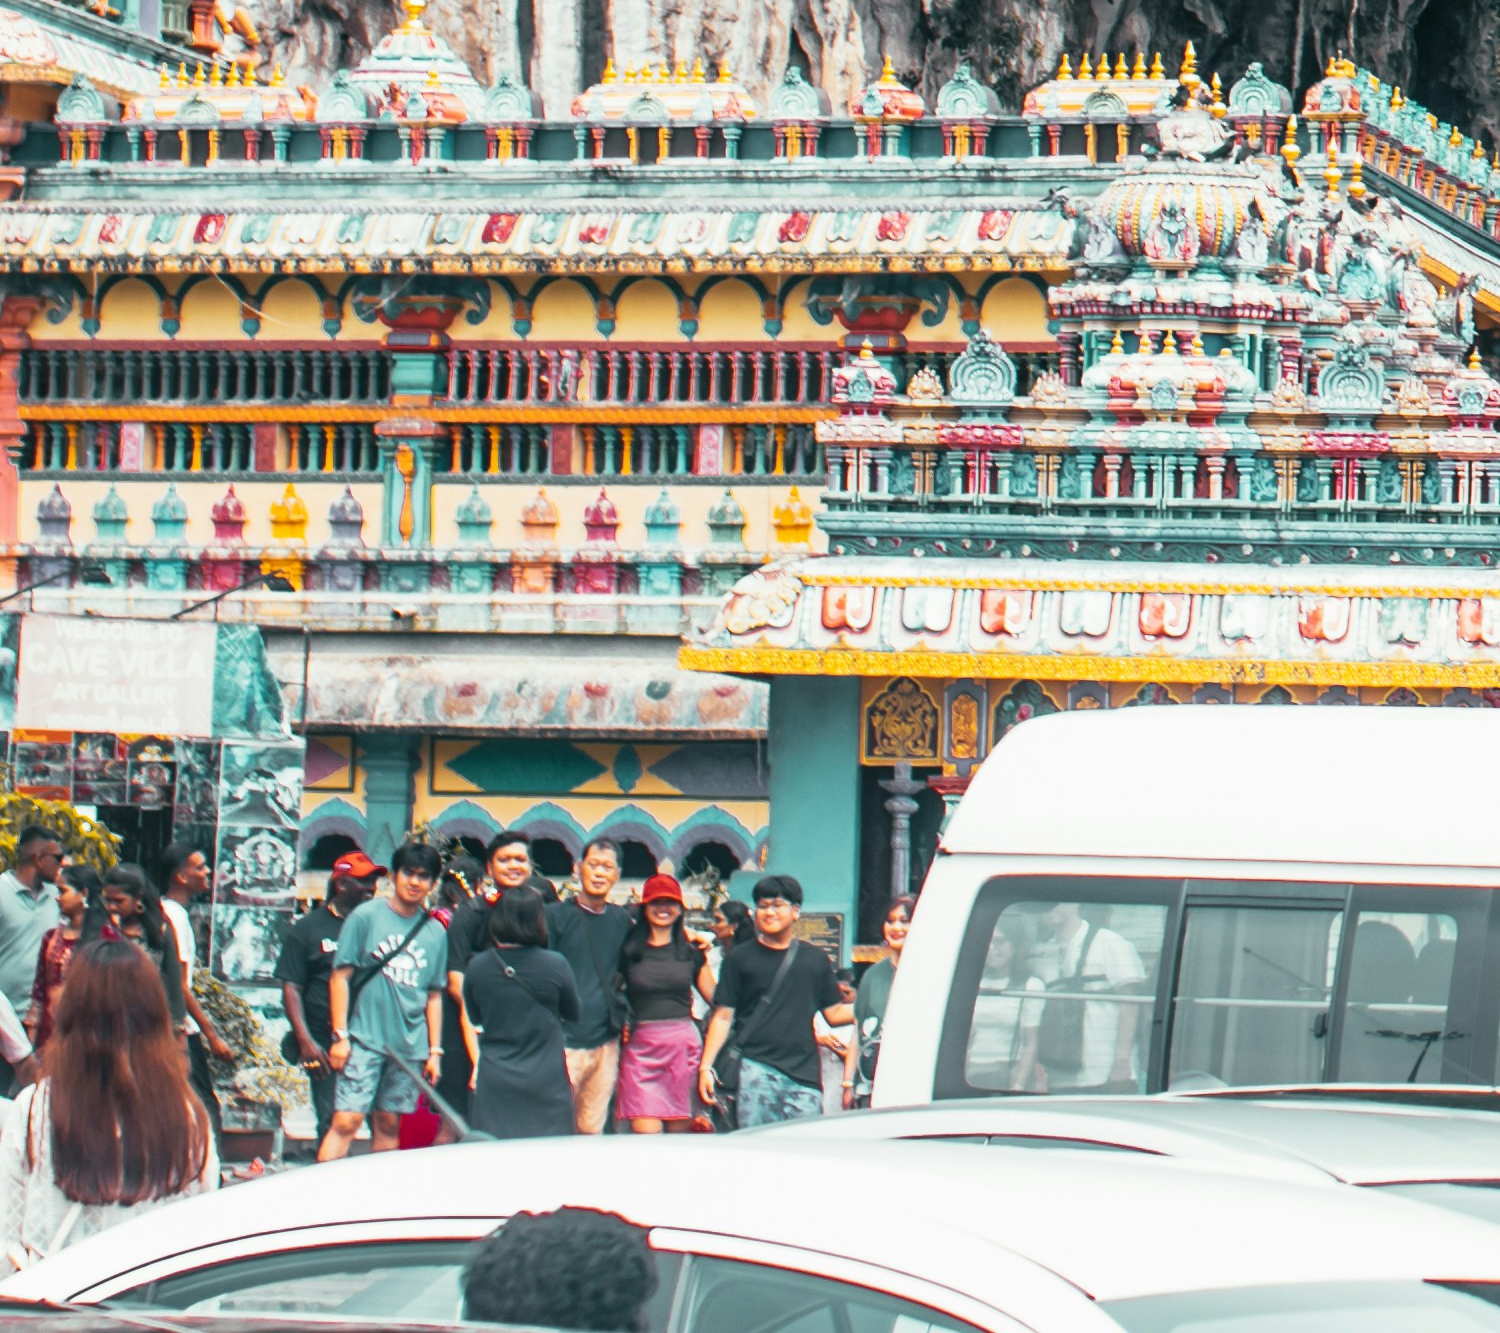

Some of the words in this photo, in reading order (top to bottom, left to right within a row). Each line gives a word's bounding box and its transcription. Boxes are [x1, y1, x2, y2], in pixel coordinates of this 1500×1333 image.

[56, 619, 151, 640] WELCOME
[158, 622, 182, 641] TO
[27, 642, 109, 676] CAVE
[117, 648, 207, 678] VILLA
[52, 682, 91, 702] ART
[94, 684, 178, 704] GALLERY
